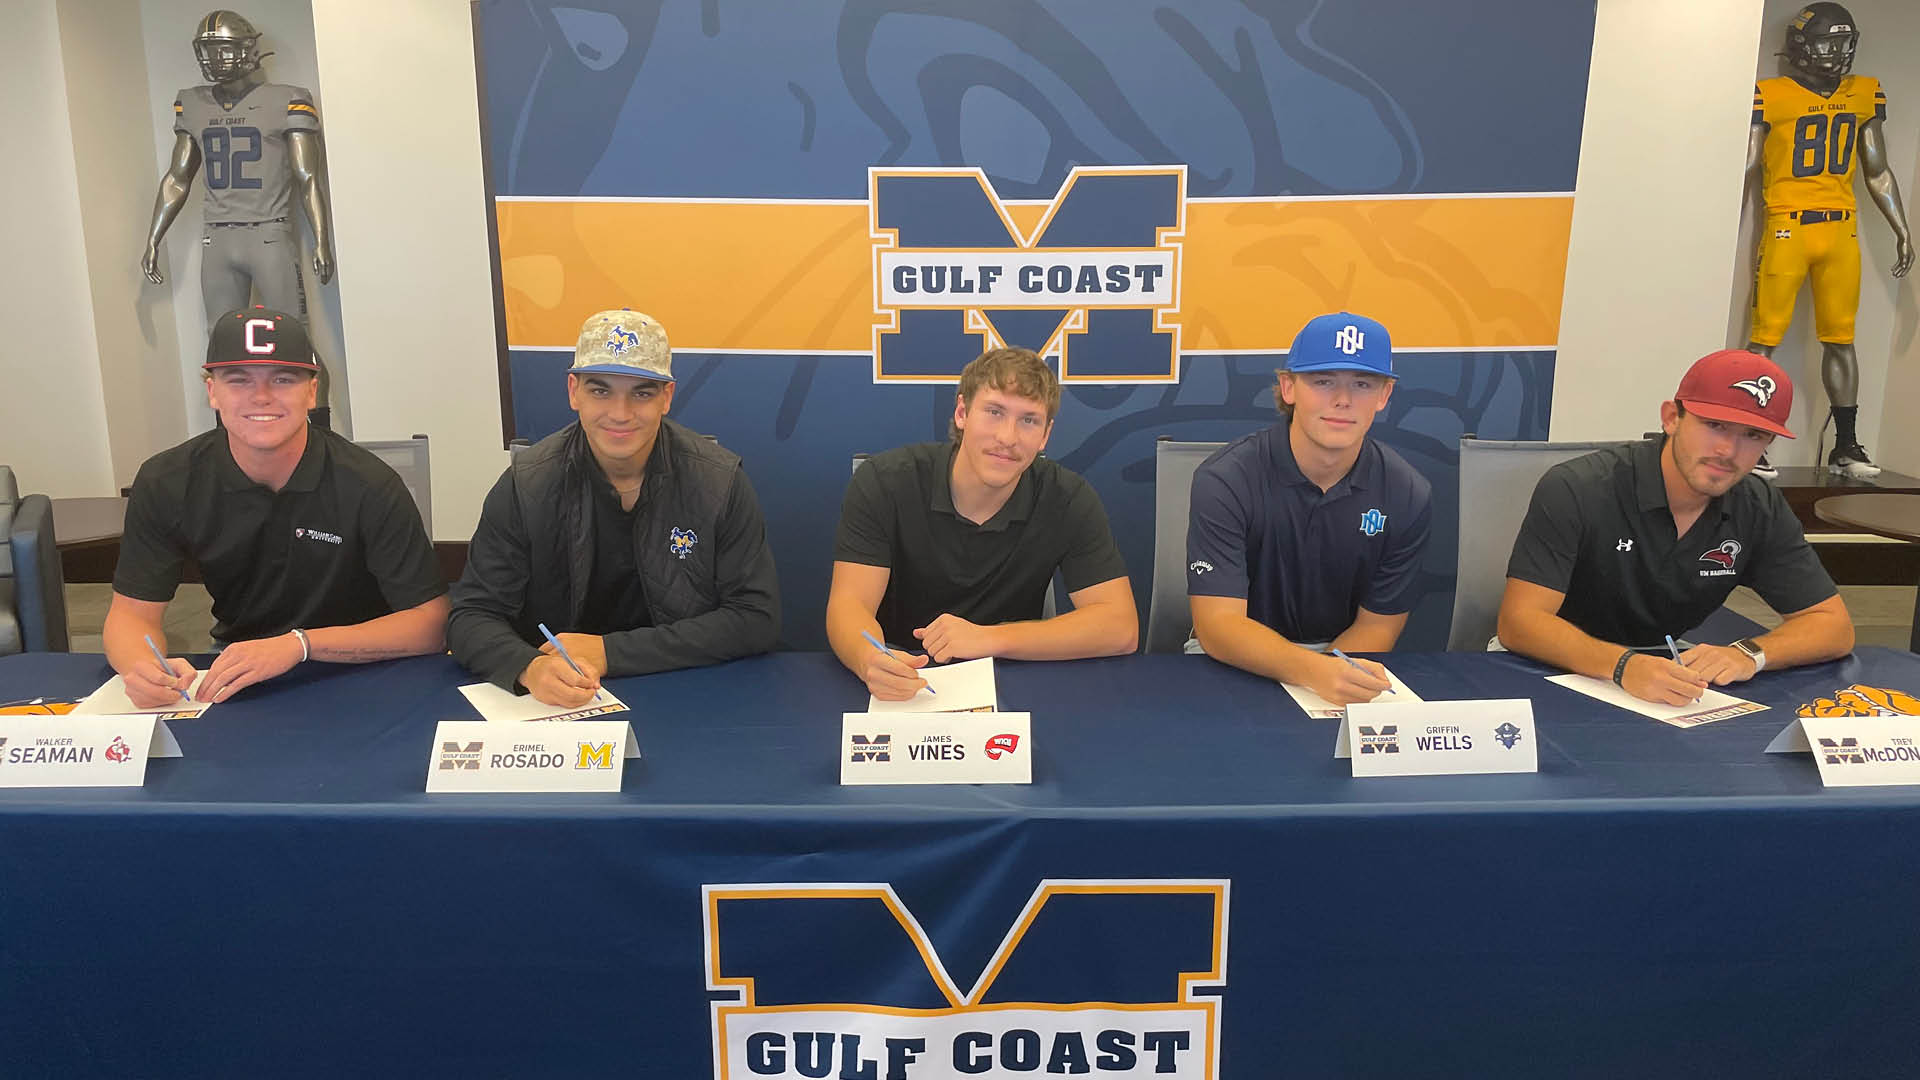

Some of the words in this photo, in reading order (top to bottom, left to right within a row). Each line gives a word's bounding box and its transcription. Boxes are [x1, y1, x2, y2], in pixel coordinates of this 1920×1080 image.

[1808, 104, 1824, 113] GULF
[1828, 103, 1847, 111] COAST
[1791, 112, 1857, 177] 80
[202, 127, 262, 190] 82
[892, 265, 1002, 293] GULF
[1018, 264, 1164, 293] COAST
[245, 319, 276, 355] C
[1426, 726, 1460, 735] GRIFFIN
[35, 738, 73, 746] WALKER
[921, 735, 952, 743] JAMES
[1415, 735, 1473, 751] WELLS
[1890, 738, 1913, 746] TREY
[8, 747, 94, 764] SEAMAN
[513, 744, 546, 752] ERIMEL
[907, 744, 966, 761] VINES
[490, 753, 565, 769] ROSADO
[746, 1031, 926, 1080] GULF
[953, 1029, 1191, 1075] COAST
